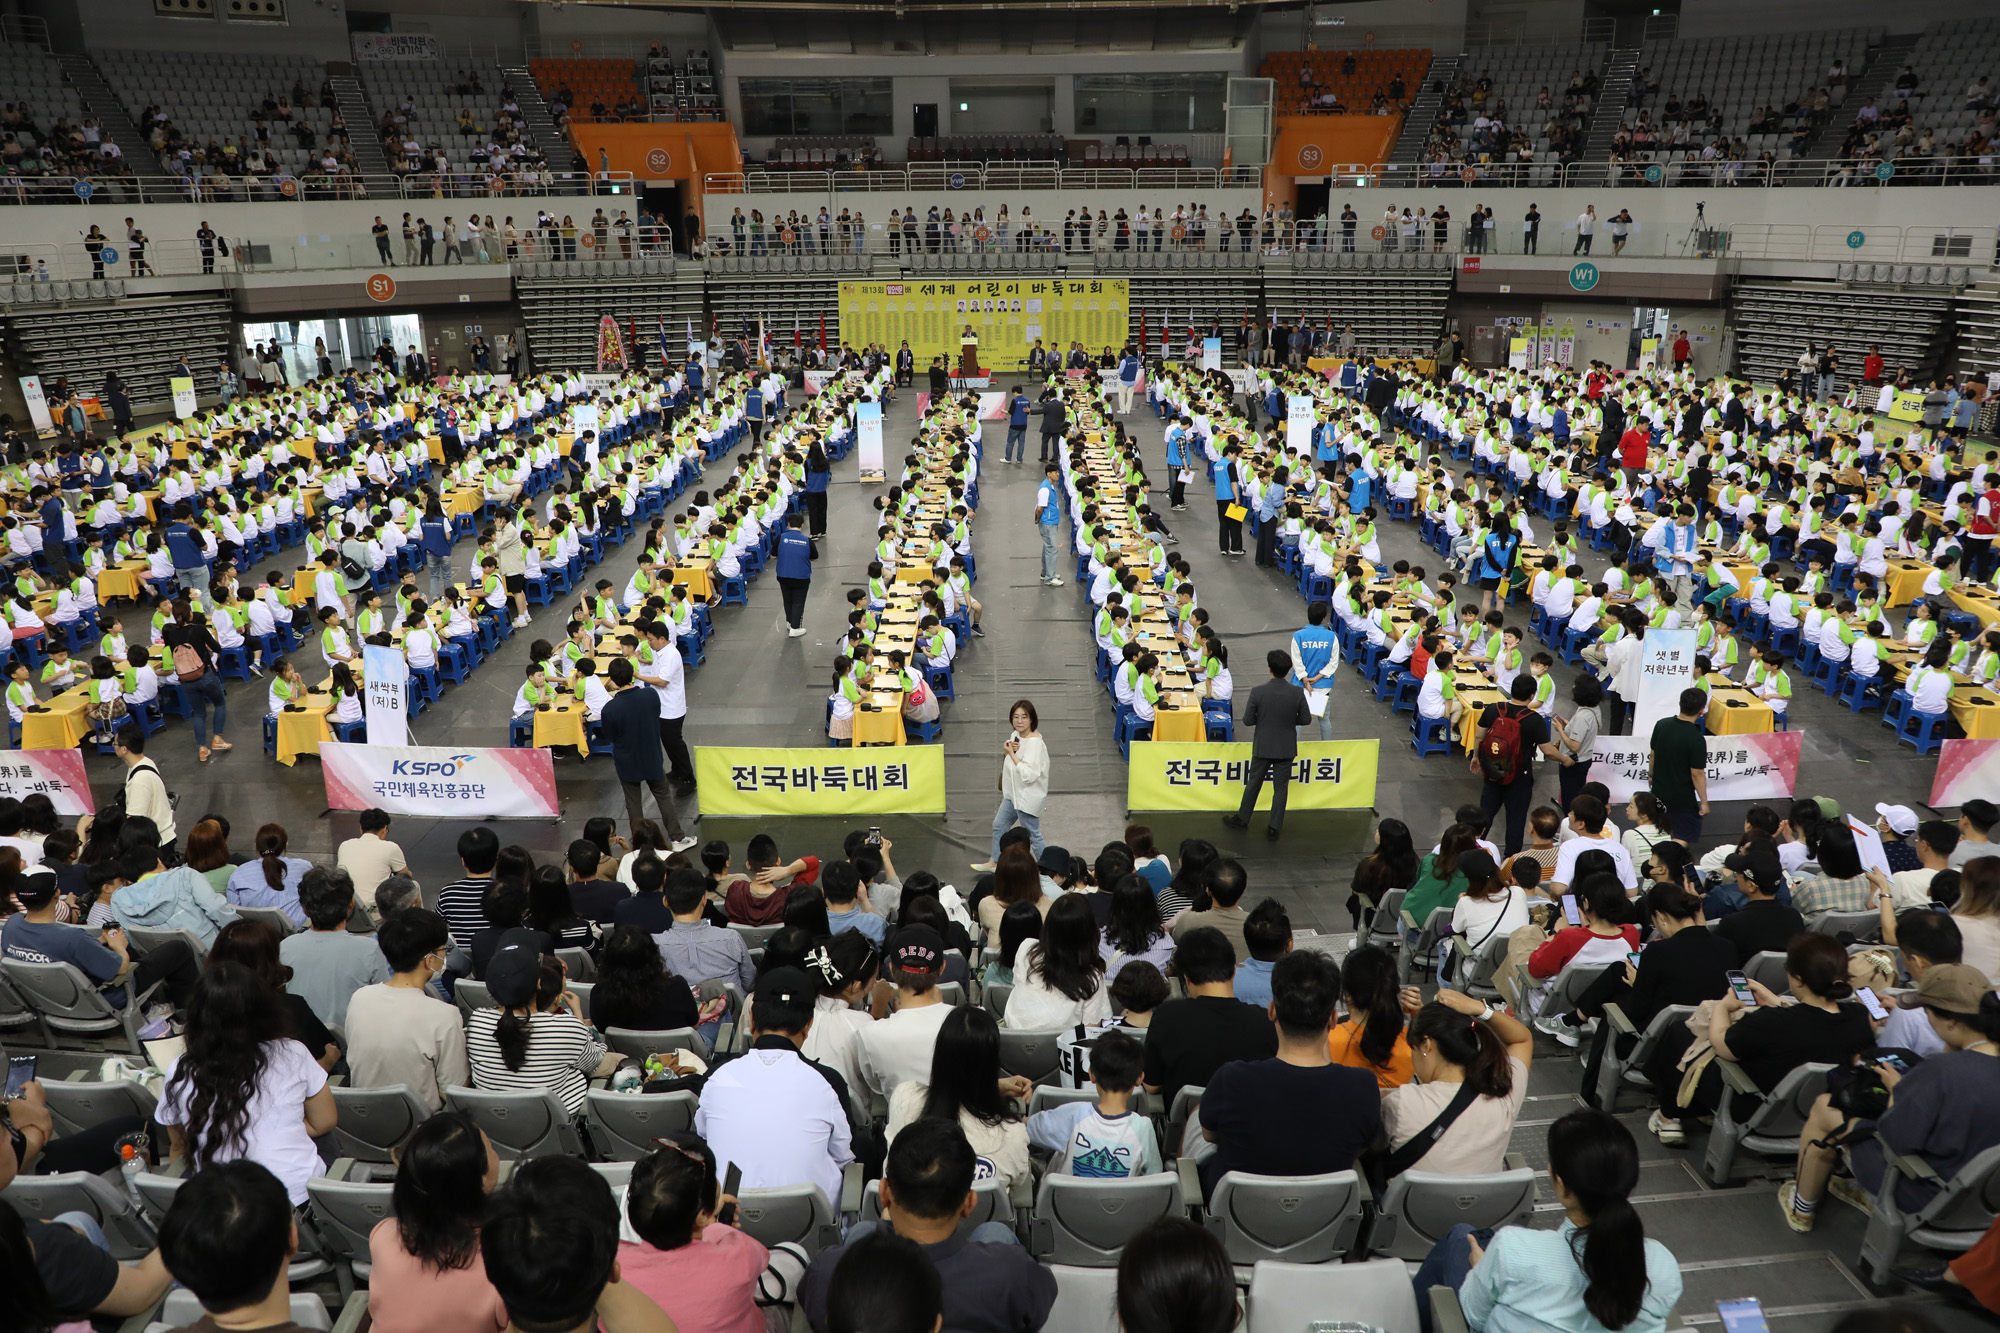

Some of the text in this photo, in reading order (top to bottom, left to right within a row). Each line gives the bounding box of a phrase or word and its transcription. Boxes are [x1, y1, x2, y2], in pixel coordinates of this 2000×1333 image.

[397, 46, 423, 55] 대기석
[651, 155, 666, 165] S2
[1303, 151, 1318, 160] S3
[1575, 268, 1593, 280] W1
[373, 280, 389, 291] S1
[861, 286, 884, 294] 제13회
[920, 284, 955, 296] 세계
[967, 283, 1018, 297] 어린이
[1032, 281, 1102, 297] 바둑대회
[27, 393, 43, 401] 의료석
[1302, 641, 1329, 649] STAFF
[1656, 651, 1679, 661] 샛별
[1644, 664, 1689, 675] 저학년부
[369, 681, 399, 695] 새싹부
[392, 759, 456, 777] KSPO
[1165, 757, 1342, 786] 전국바대회
[731, 763, 909, 793] 전국바둑대회
[373, 781, 486, 799] 국민체육진흥공단
[898, 946, 936, 961] REDS
